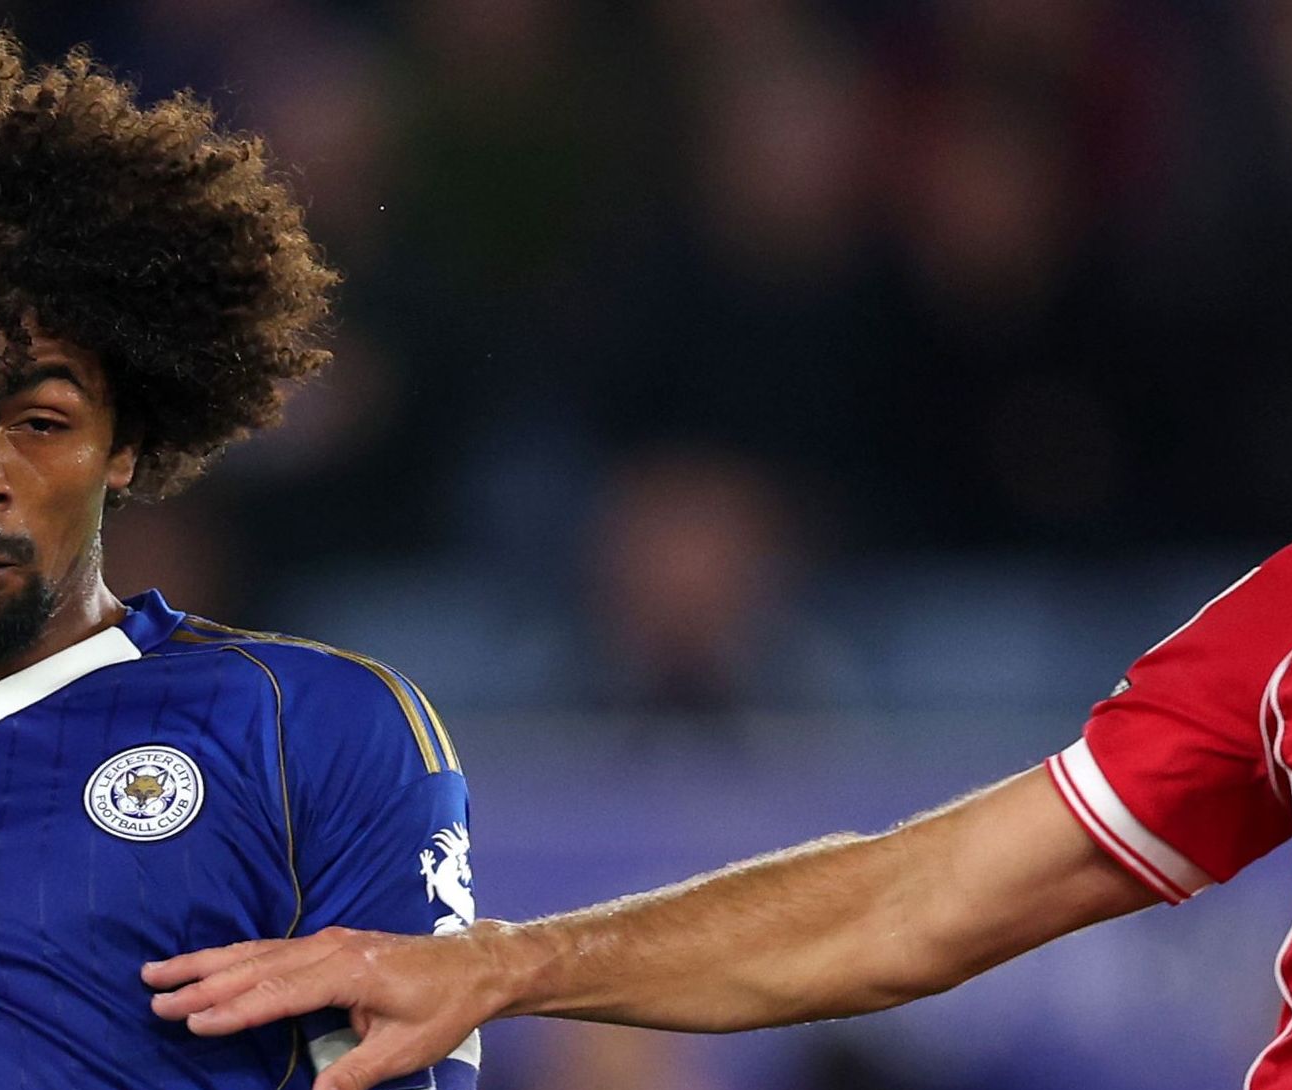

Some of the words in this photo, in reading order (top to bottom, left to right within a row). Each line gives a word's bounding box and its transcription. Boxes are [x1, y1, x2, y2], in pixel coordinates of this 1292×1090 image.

[100, 754, 173, 788] LEICESTER
[174, 764, 191, 792] CITY
[97, 795, 156, 831] FOOTBALL
[159, 799, 189, 828] CLUB
